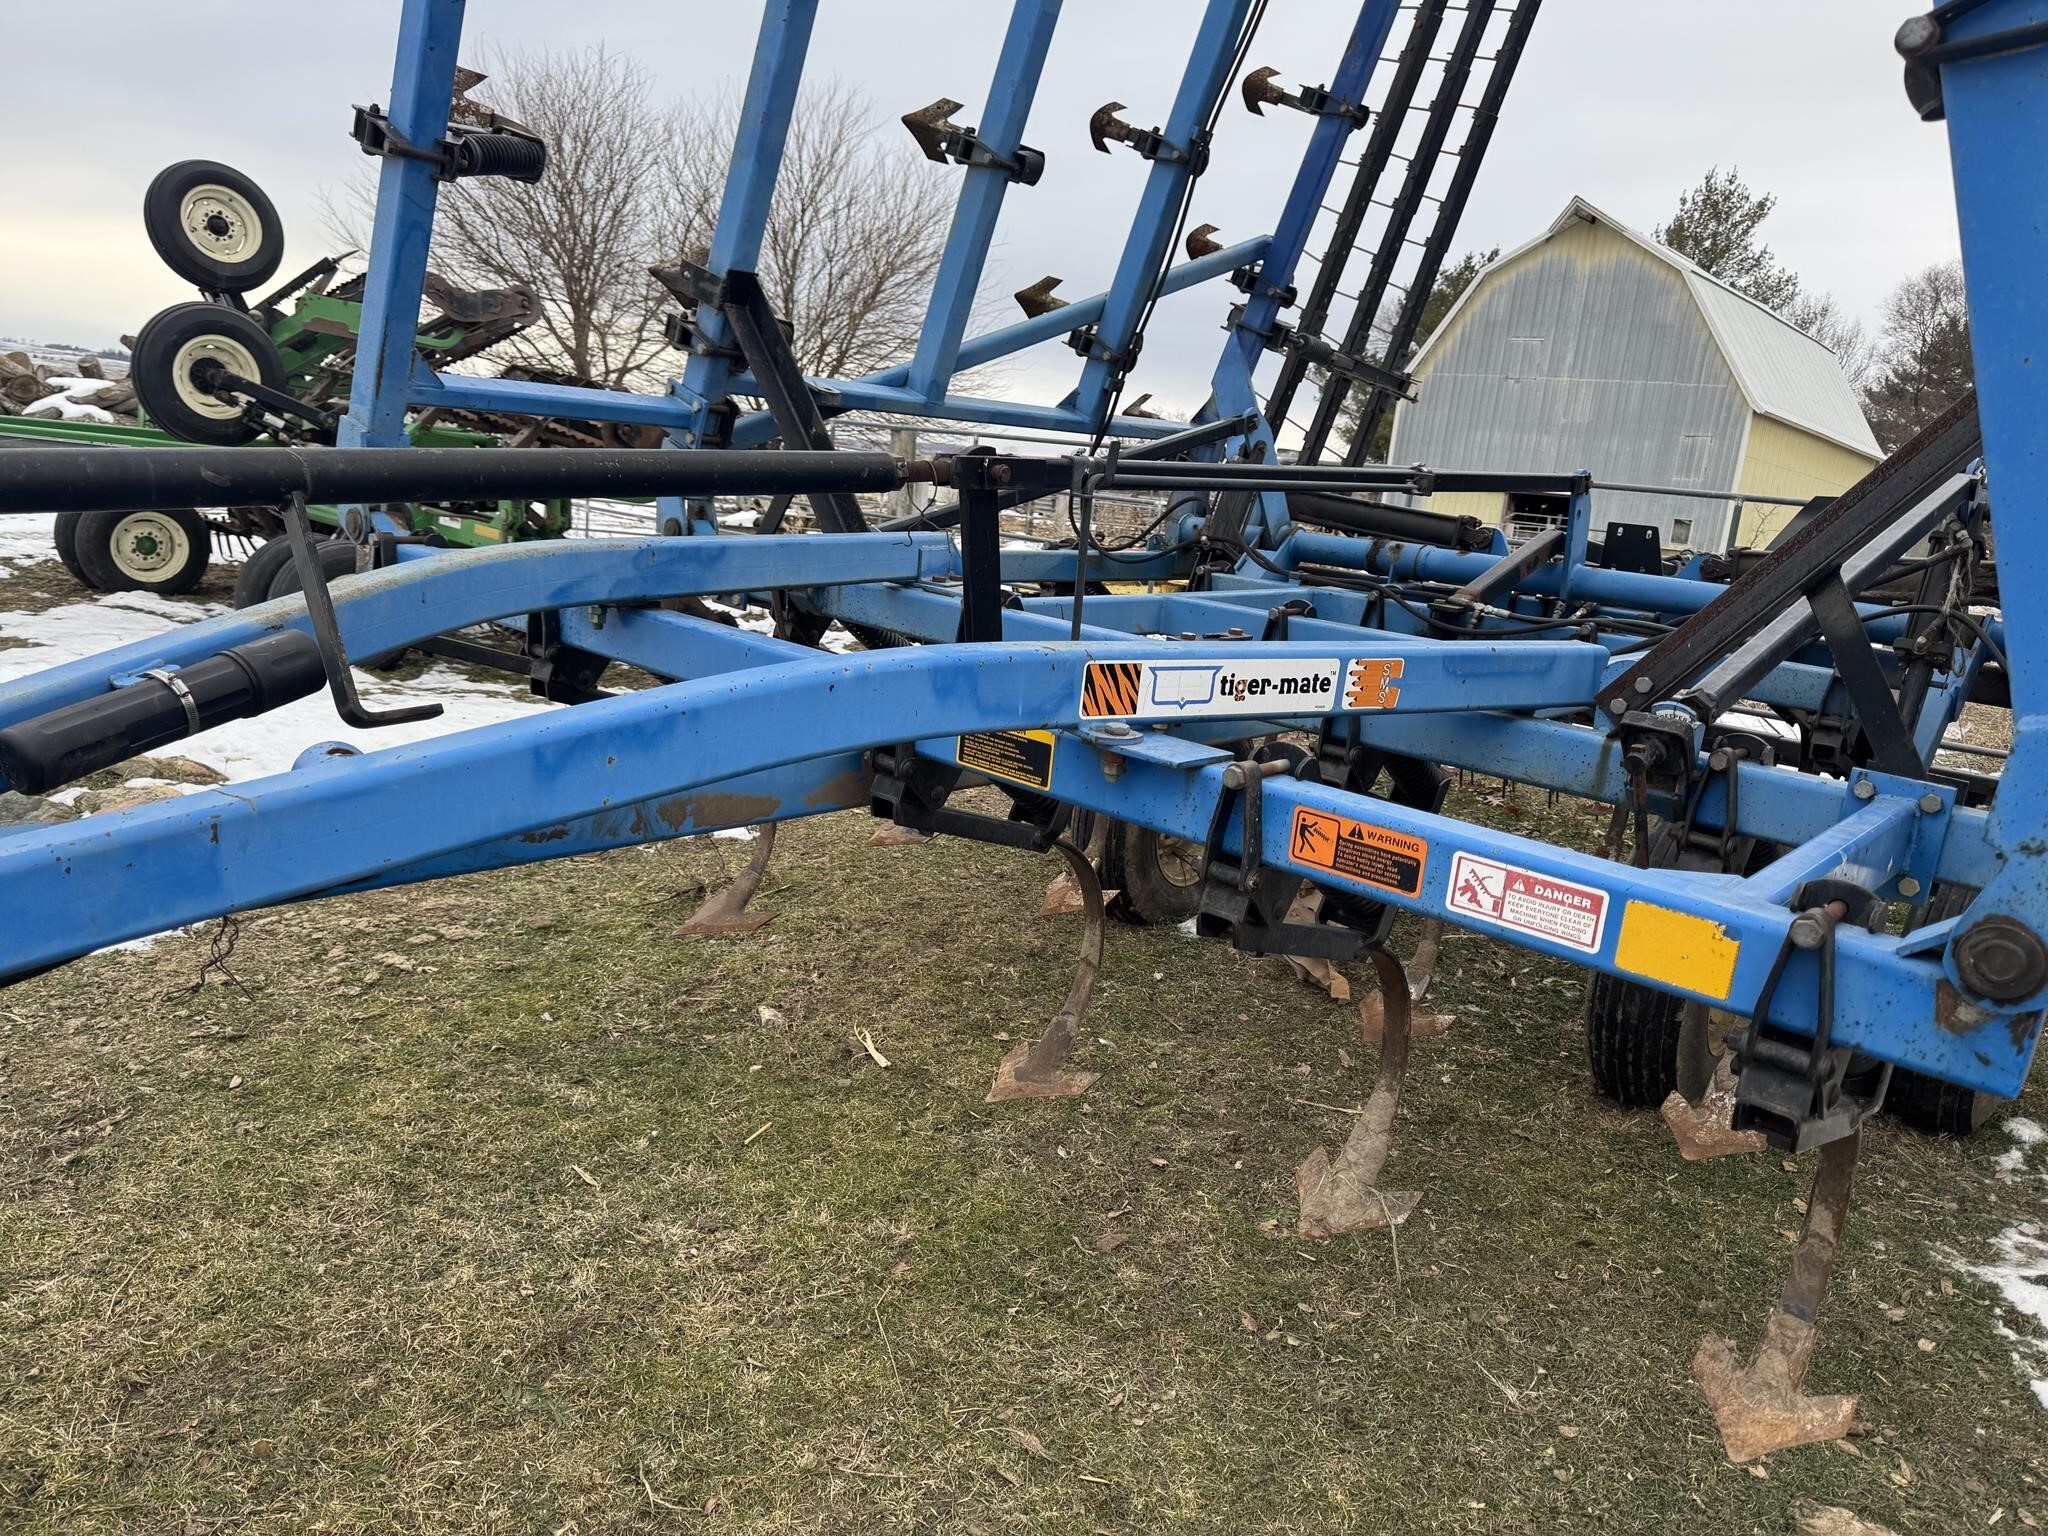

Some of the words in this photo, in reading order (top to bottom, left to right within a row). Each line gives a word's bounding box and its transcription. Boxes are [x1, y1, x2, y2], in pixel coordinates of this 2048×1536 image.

[1220, 672, 1331, 702] tiger-mate
[1367, 830, 1419, 852] WARNING
[1344, 852, 1356, 861] avoid
[1356, 856, 1370, 866] bodily
[1381, 850, 1391, 859] have
[1392, 855, 1417, 867] potentially
[1384, 870, 1400, 880] service
[1517, 895, 1536, 906] AVOID
[1538, 901, 1561, 912] INJURY
[1563, 908, 1571, 916] OR
[1573, 911, 1594, 922] DEATH
[1535, 885, 1592, 909] DANGER
[1508, 900, 1524, 910] KEEP
[1526, 905, 1559, 919] EVERYONE
[1561, 915, 1581, 926] CLEAR
[1510, 908, 1538, 921] MACHINE
[1540, 917, 1558, 926] WHEN
[1559, 922, 1587, 935] FOLDING
[1513, 915, 1522, 923] OR
[1524, 918, 1559, 934] UNFOLDING
[1561, 930, 1581, 940] WINGS
